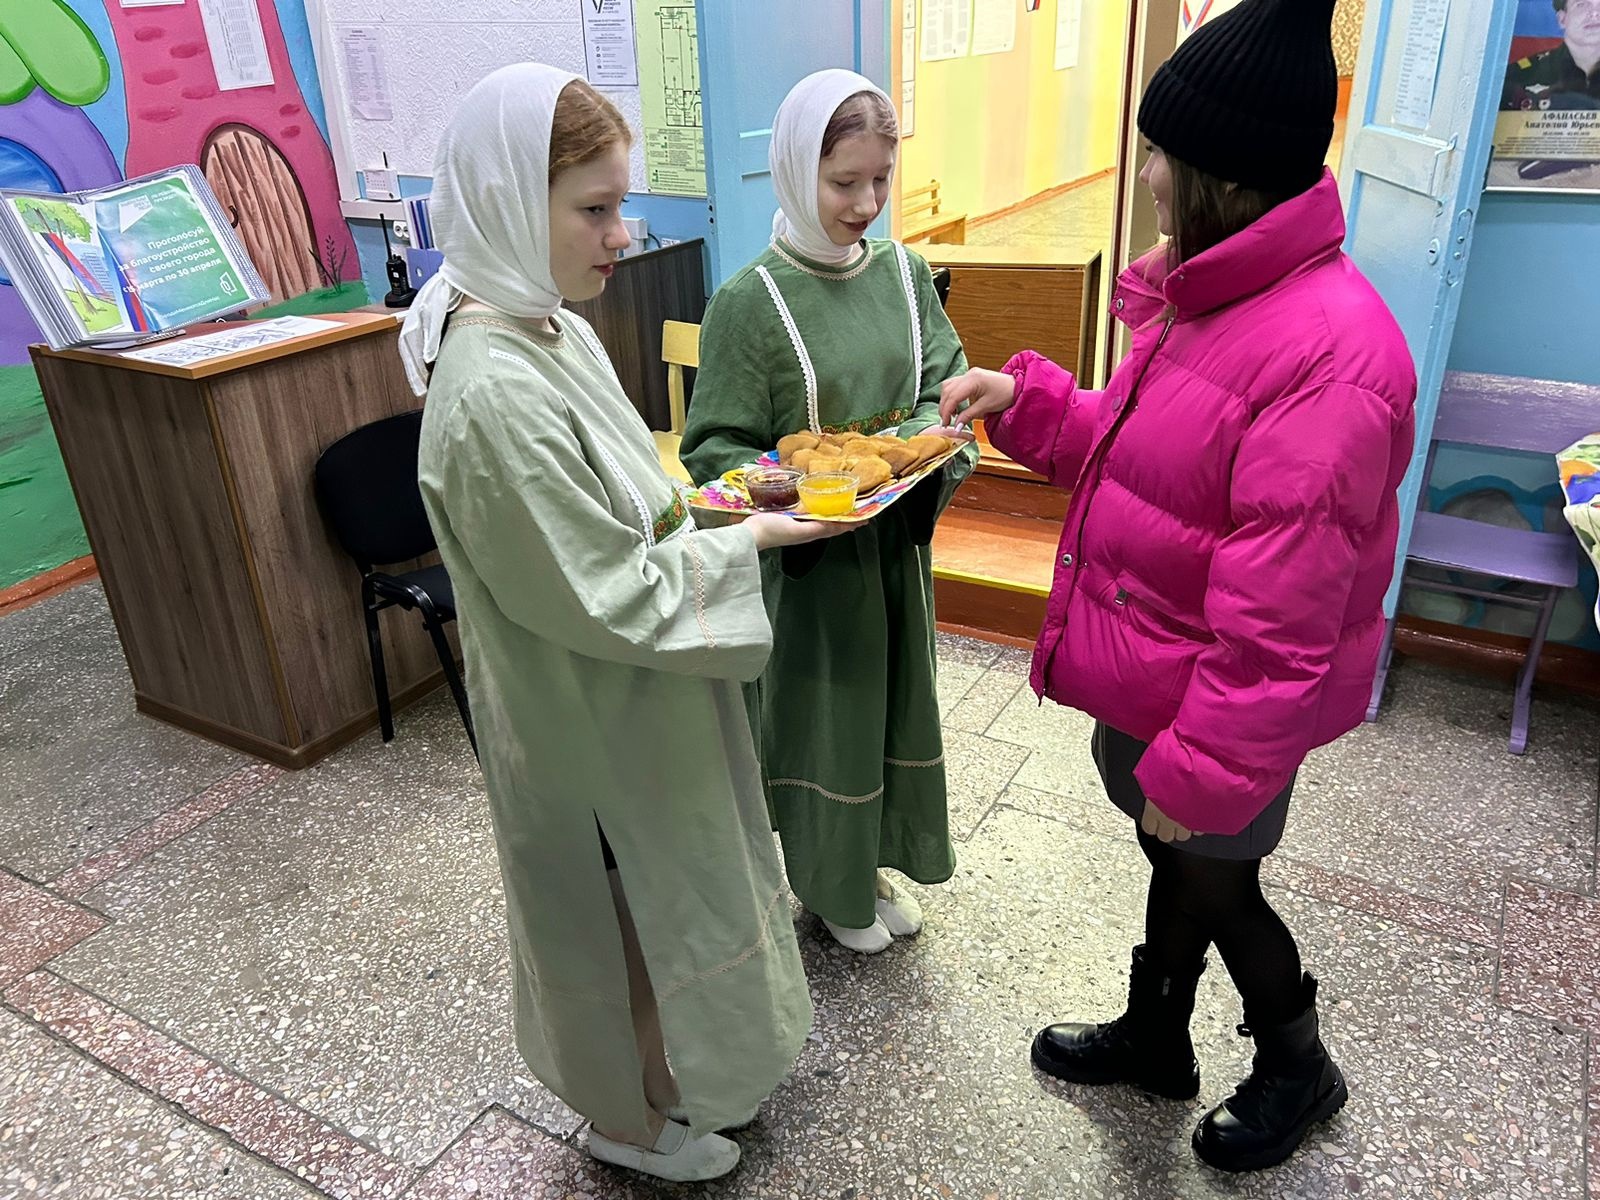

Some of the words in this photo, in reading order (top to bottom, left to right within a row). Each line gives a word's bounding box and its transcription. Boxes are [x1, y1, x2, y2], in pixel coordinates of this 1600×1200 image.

[1524, 121, 1568, 129] Анатолий
[1541, 112, 1597, 121] АФАНАСЬЕВ
[147, 226, 205, 250] Проголосуй
[130, 237, 210, 268] благоустройство
[149, 257, 181, 273] своего
[182, 247, 216, 264] города
[164, 272, 177, 282] по
[176, 267, 190, 278] 30
[190, 257, 222, 274] апреля
